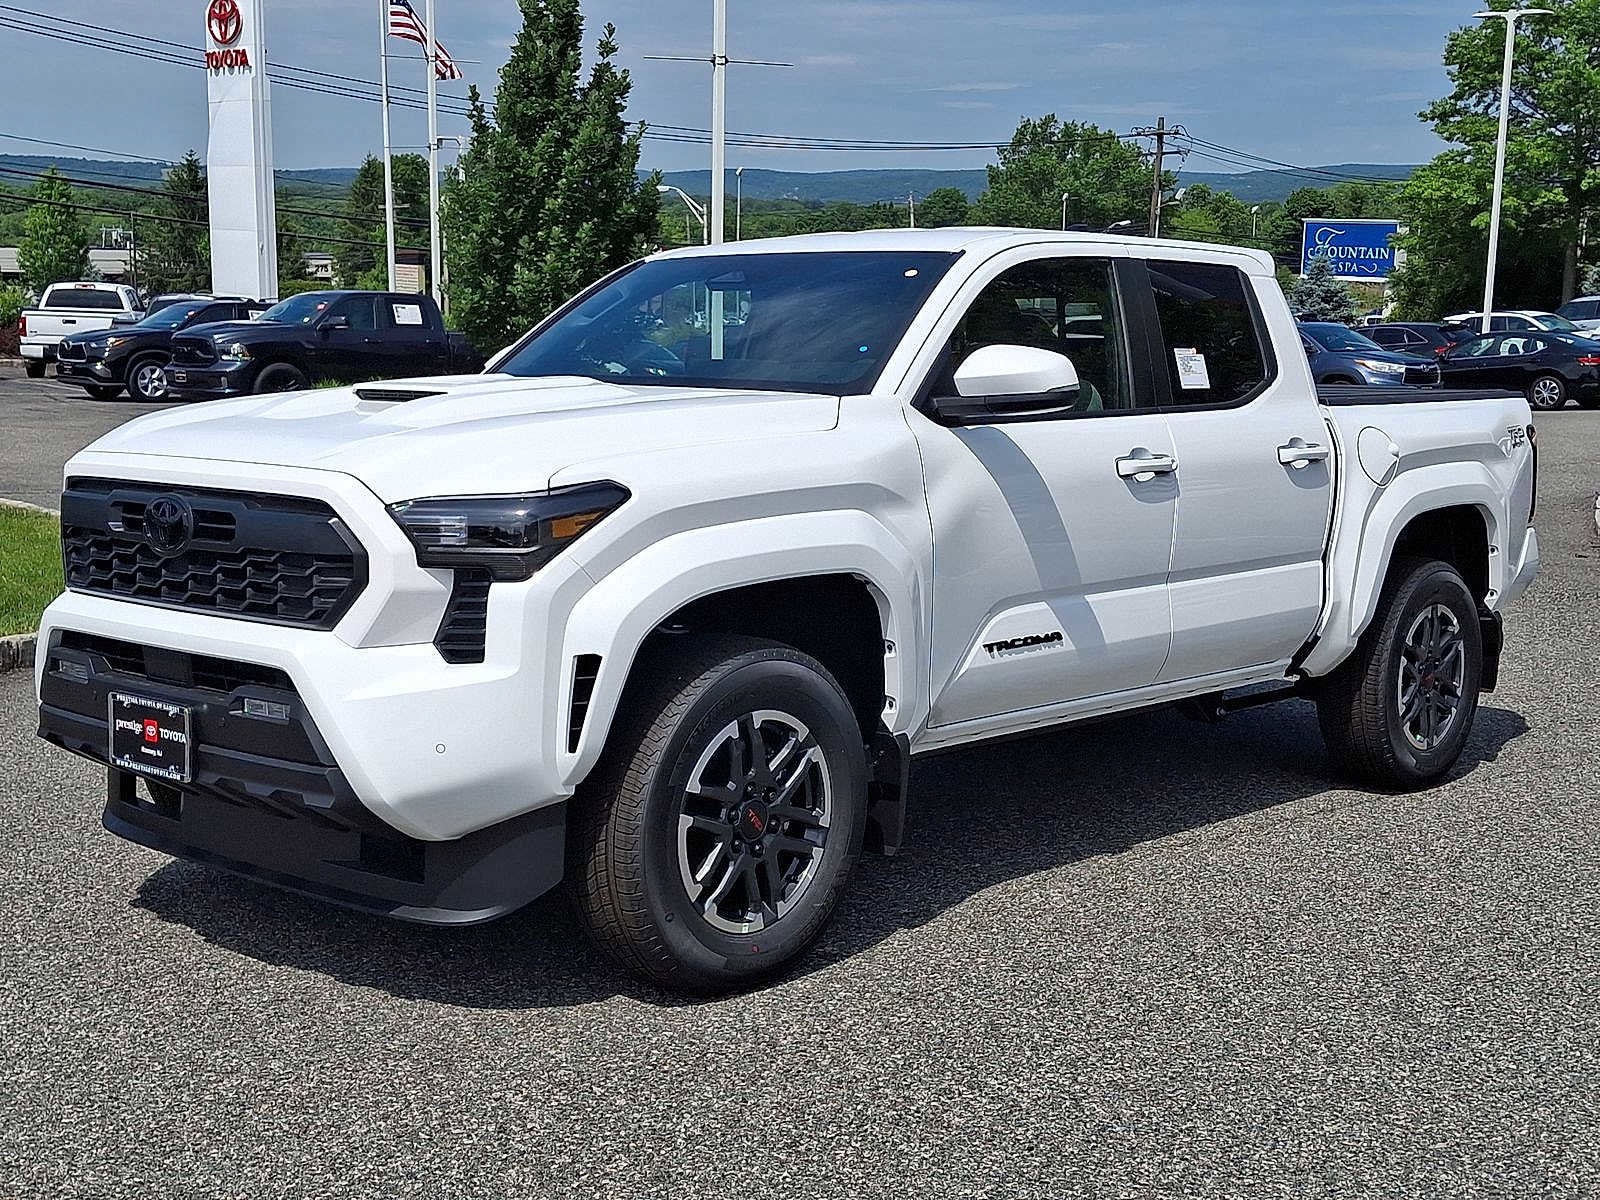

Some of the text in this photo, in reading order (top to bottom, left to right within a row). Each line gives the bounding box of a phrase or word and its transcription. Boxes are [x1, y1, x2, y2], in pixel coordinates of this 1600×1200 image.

[205, 49, 249, 69] TOYOTA
[1337, 262, 1358, 272] SPA
[982, 631, 1064, 653] TACOMA
[115, 719, 187, 743] prestige TOYOTA
